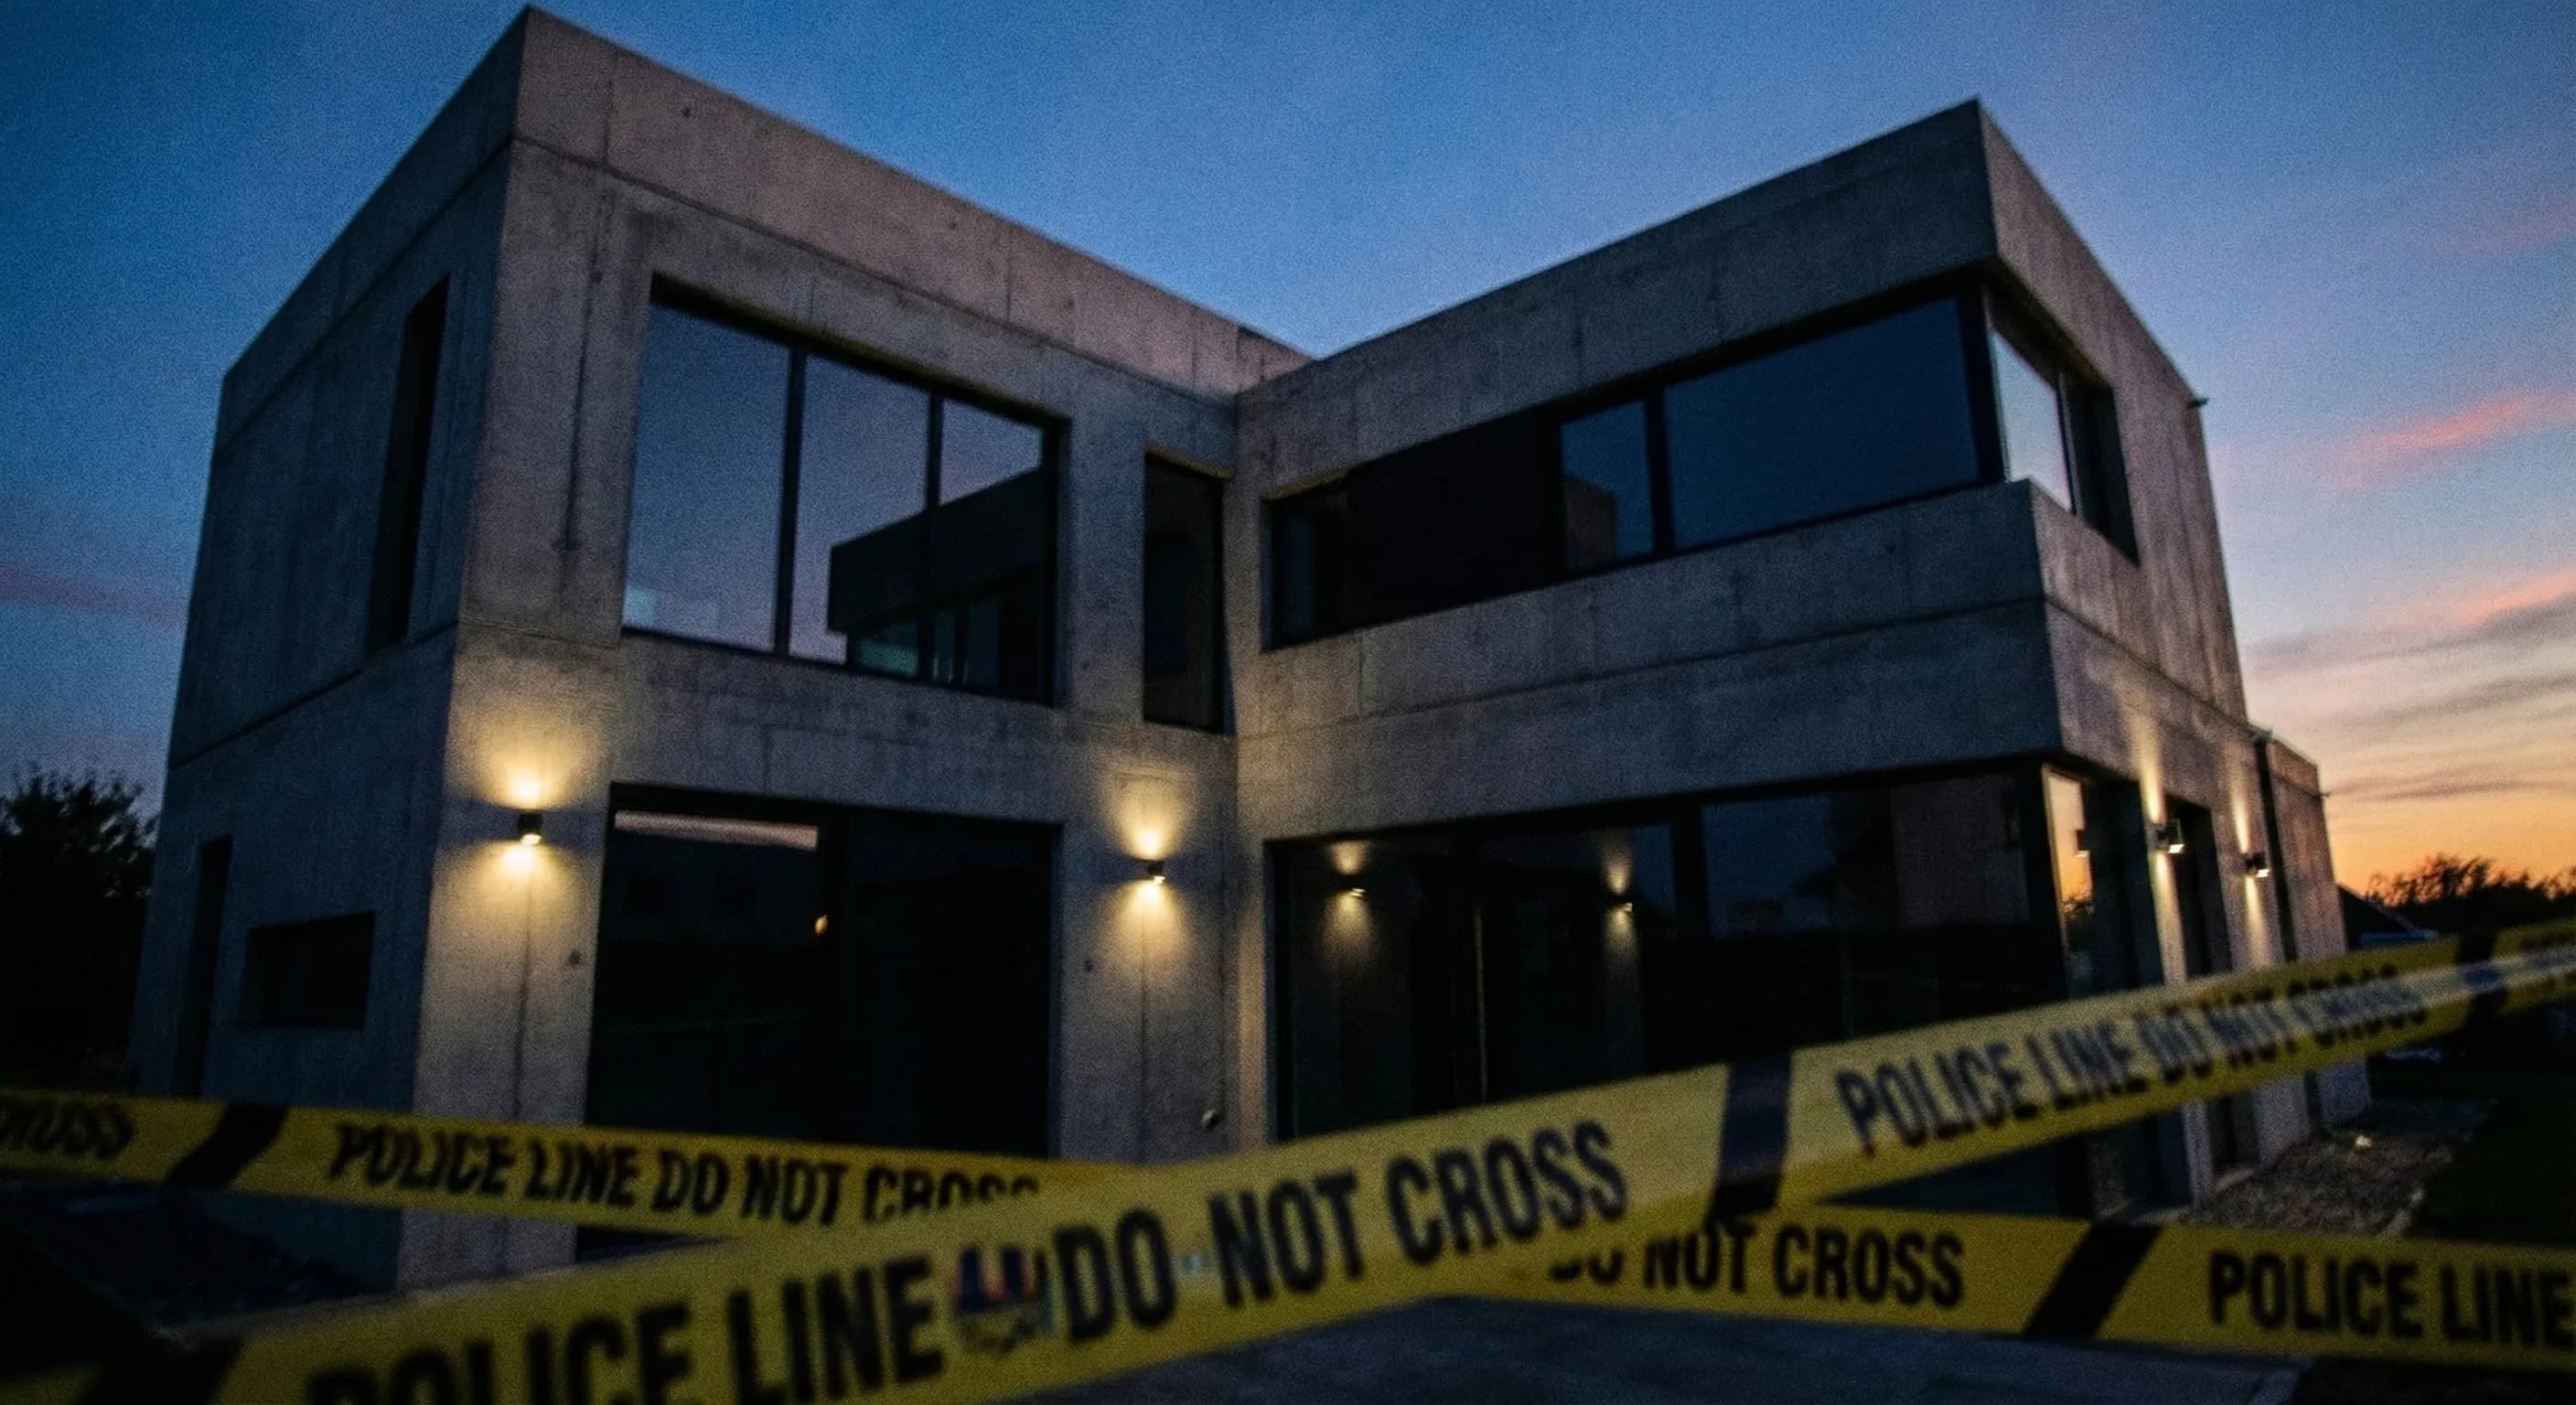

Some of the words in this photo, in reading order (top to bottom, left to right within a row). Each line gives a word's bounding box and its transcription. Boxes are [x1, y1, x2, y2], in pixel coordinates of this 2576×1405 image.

[0, 1098, 135, 1160] ROSS
[1835, 1041, 2037, 1156] POLICE
[2025, 1020, 2147, 1110] LINE
[328, 1121, 514, 1197] POLICE
[525, 1140, 638, 1207] LINE
[651, 1148, 729, 1215] DO
[741, 1156, 847, 1225] NOT
[728, 1253, 942, 1405] LINE
[1053, 1207, 1177, 1343] DO
[1208, 1164, 1363, 1308] NOT
[1386, 1121, 1628, 1269] CROSS
[1647, 1221, 1755, 1292] NOT
[1774, 1225, 1963, 1307] CROSS
[2208, 1251, 2423, 1337] POLICE
[2441, 1262, 2576, 1348] LINE
